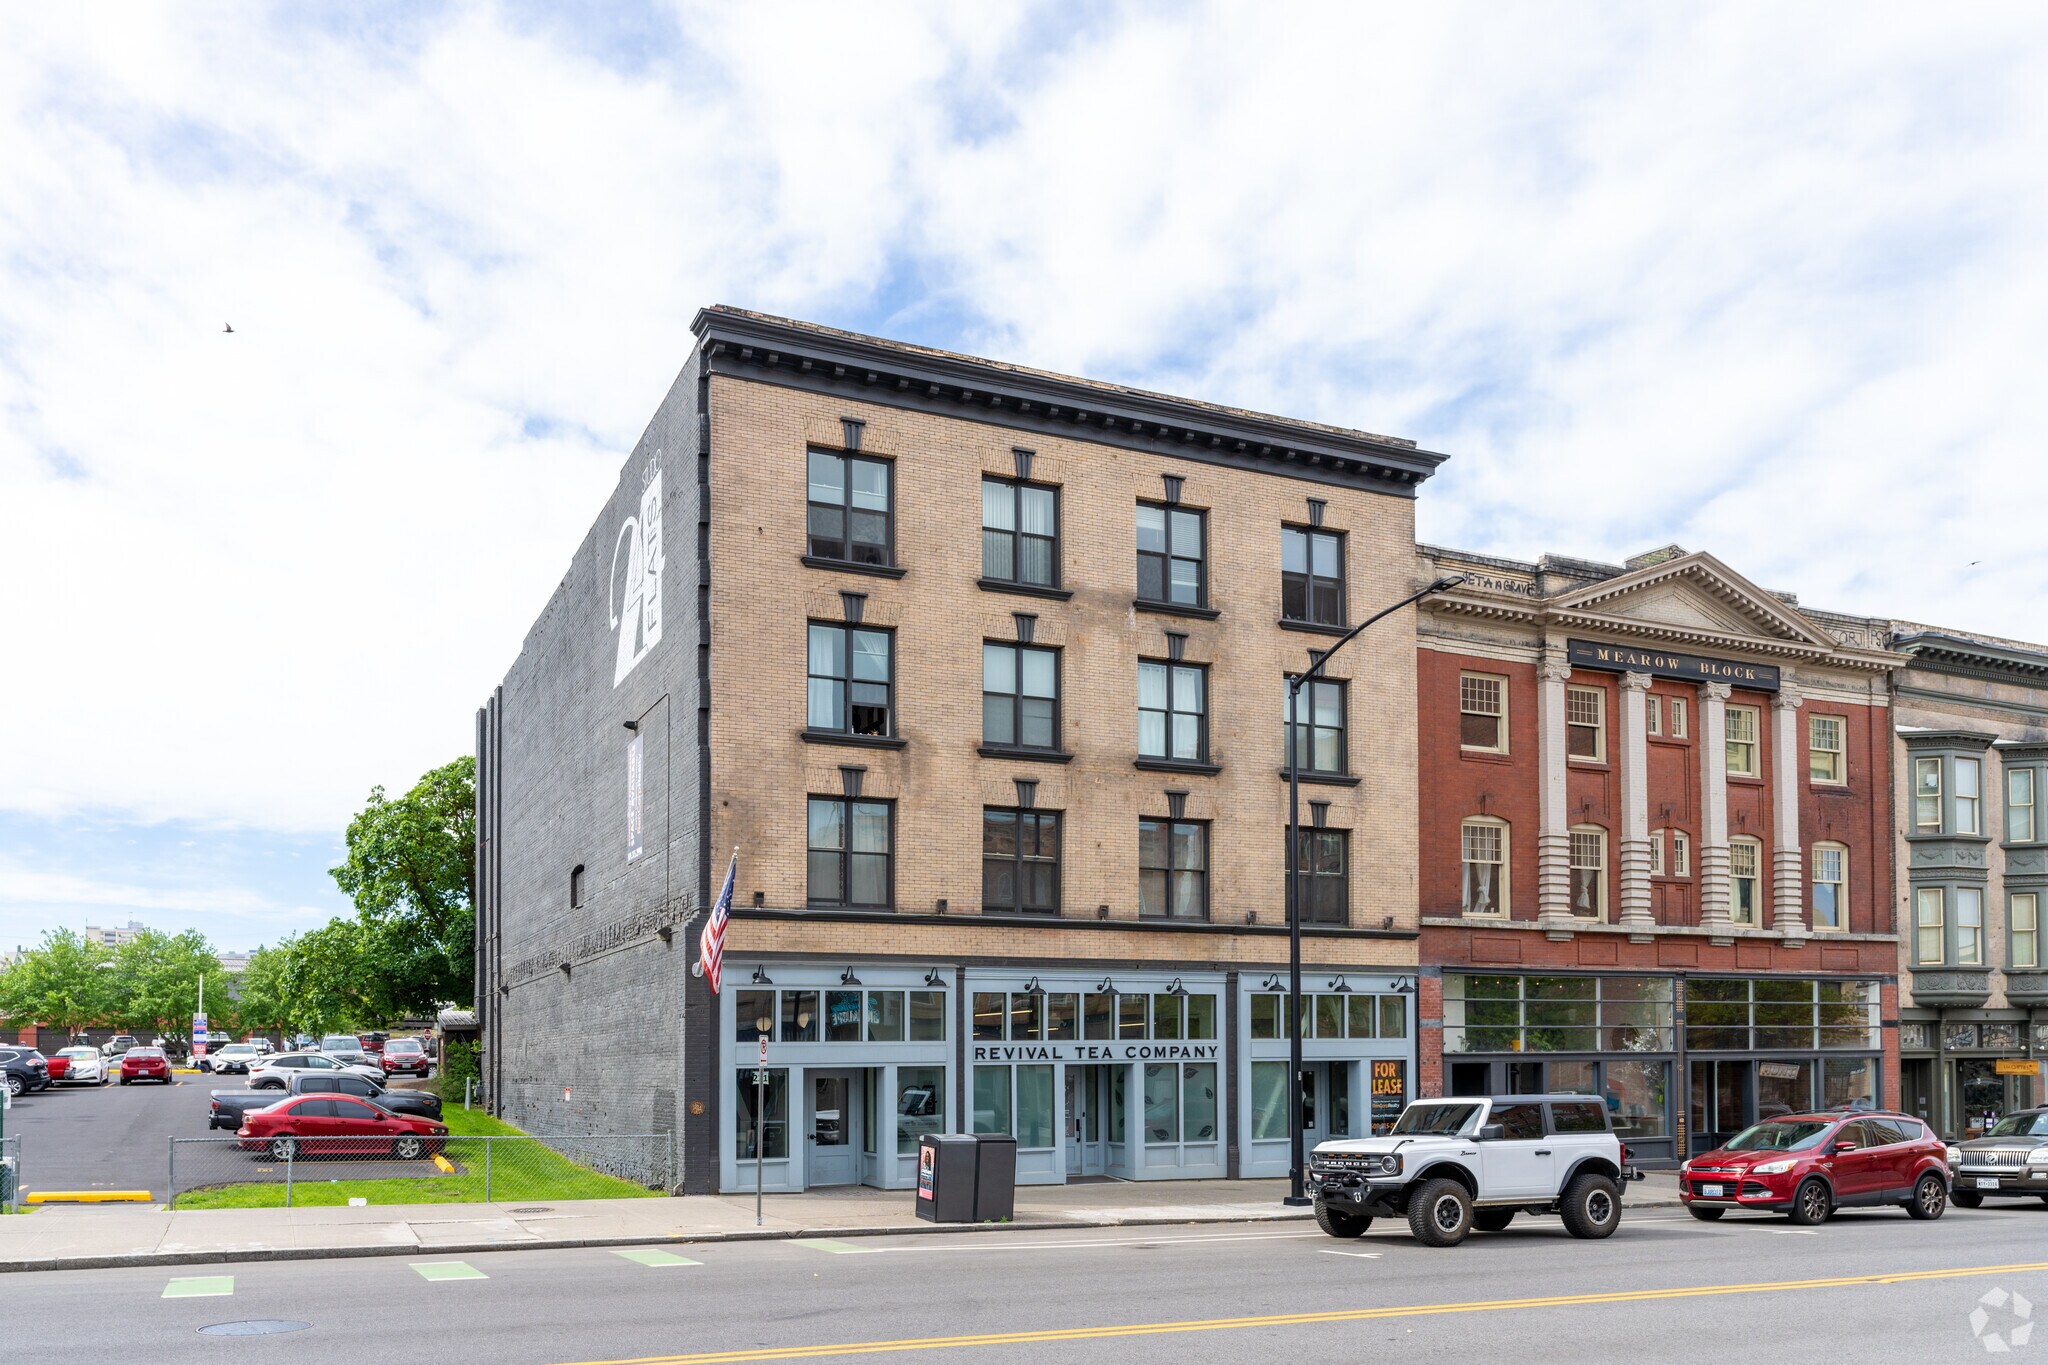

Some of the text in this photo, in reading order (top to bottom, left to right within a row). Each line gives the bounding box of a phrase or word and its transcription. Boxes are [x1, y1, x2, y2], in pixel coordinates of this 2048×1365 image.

[647, 496, 657, 632] FLATS
[1597, 649, 1755, 680] MEAROW BLOCK
[974, 1045, 1219, 1060] REVIVAL TEA COMPANY
[1374, 1062, 1396, 1077] FOR
[752, 1074, 768, 1082] 21
[1372, 1079, 1403, 1094] LEASE
